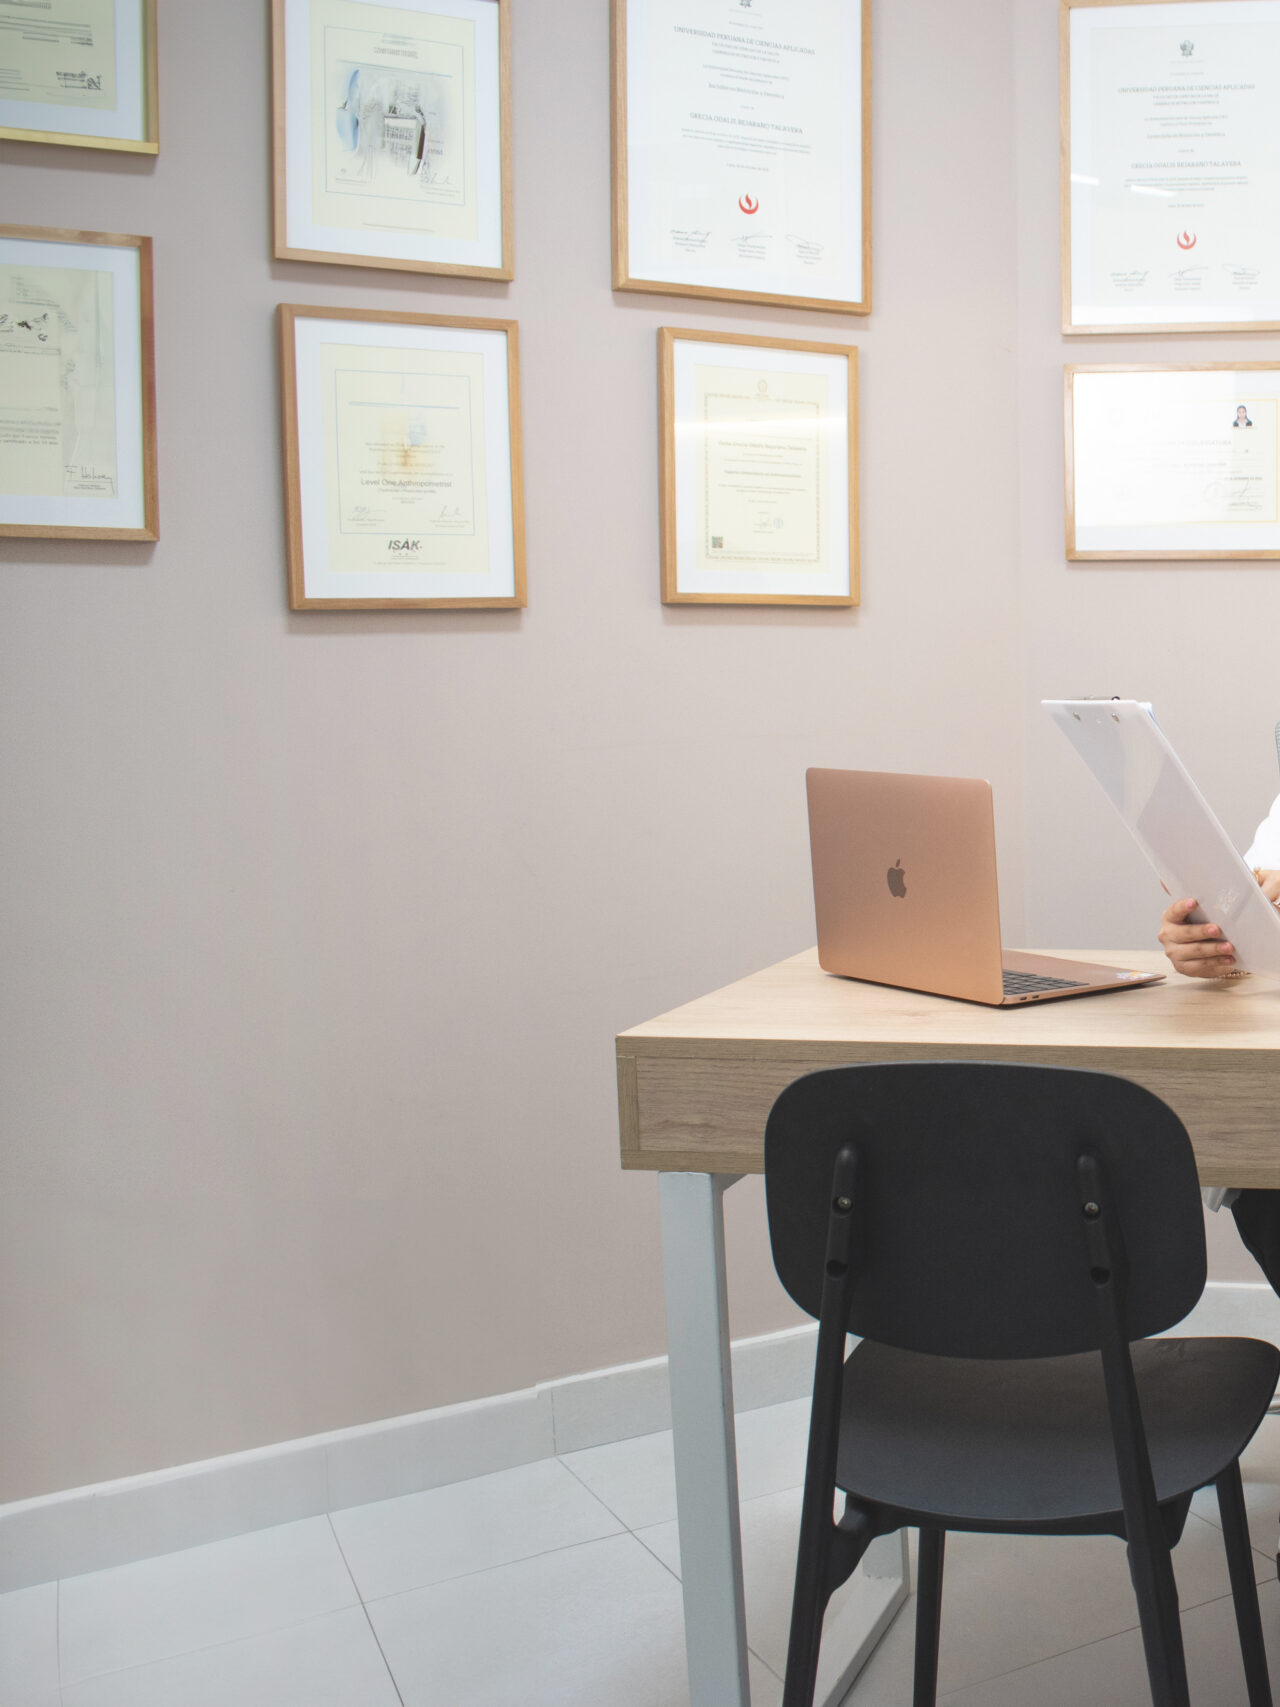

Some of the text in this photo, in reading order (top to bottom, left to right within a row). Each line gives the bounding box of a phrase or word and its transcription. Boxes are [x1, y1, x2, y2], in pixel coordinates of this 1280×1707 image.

[361, 478, 380, 487] Level
[381, 479, 396, 487] One
[388, 540, 420, 550] ISAK
